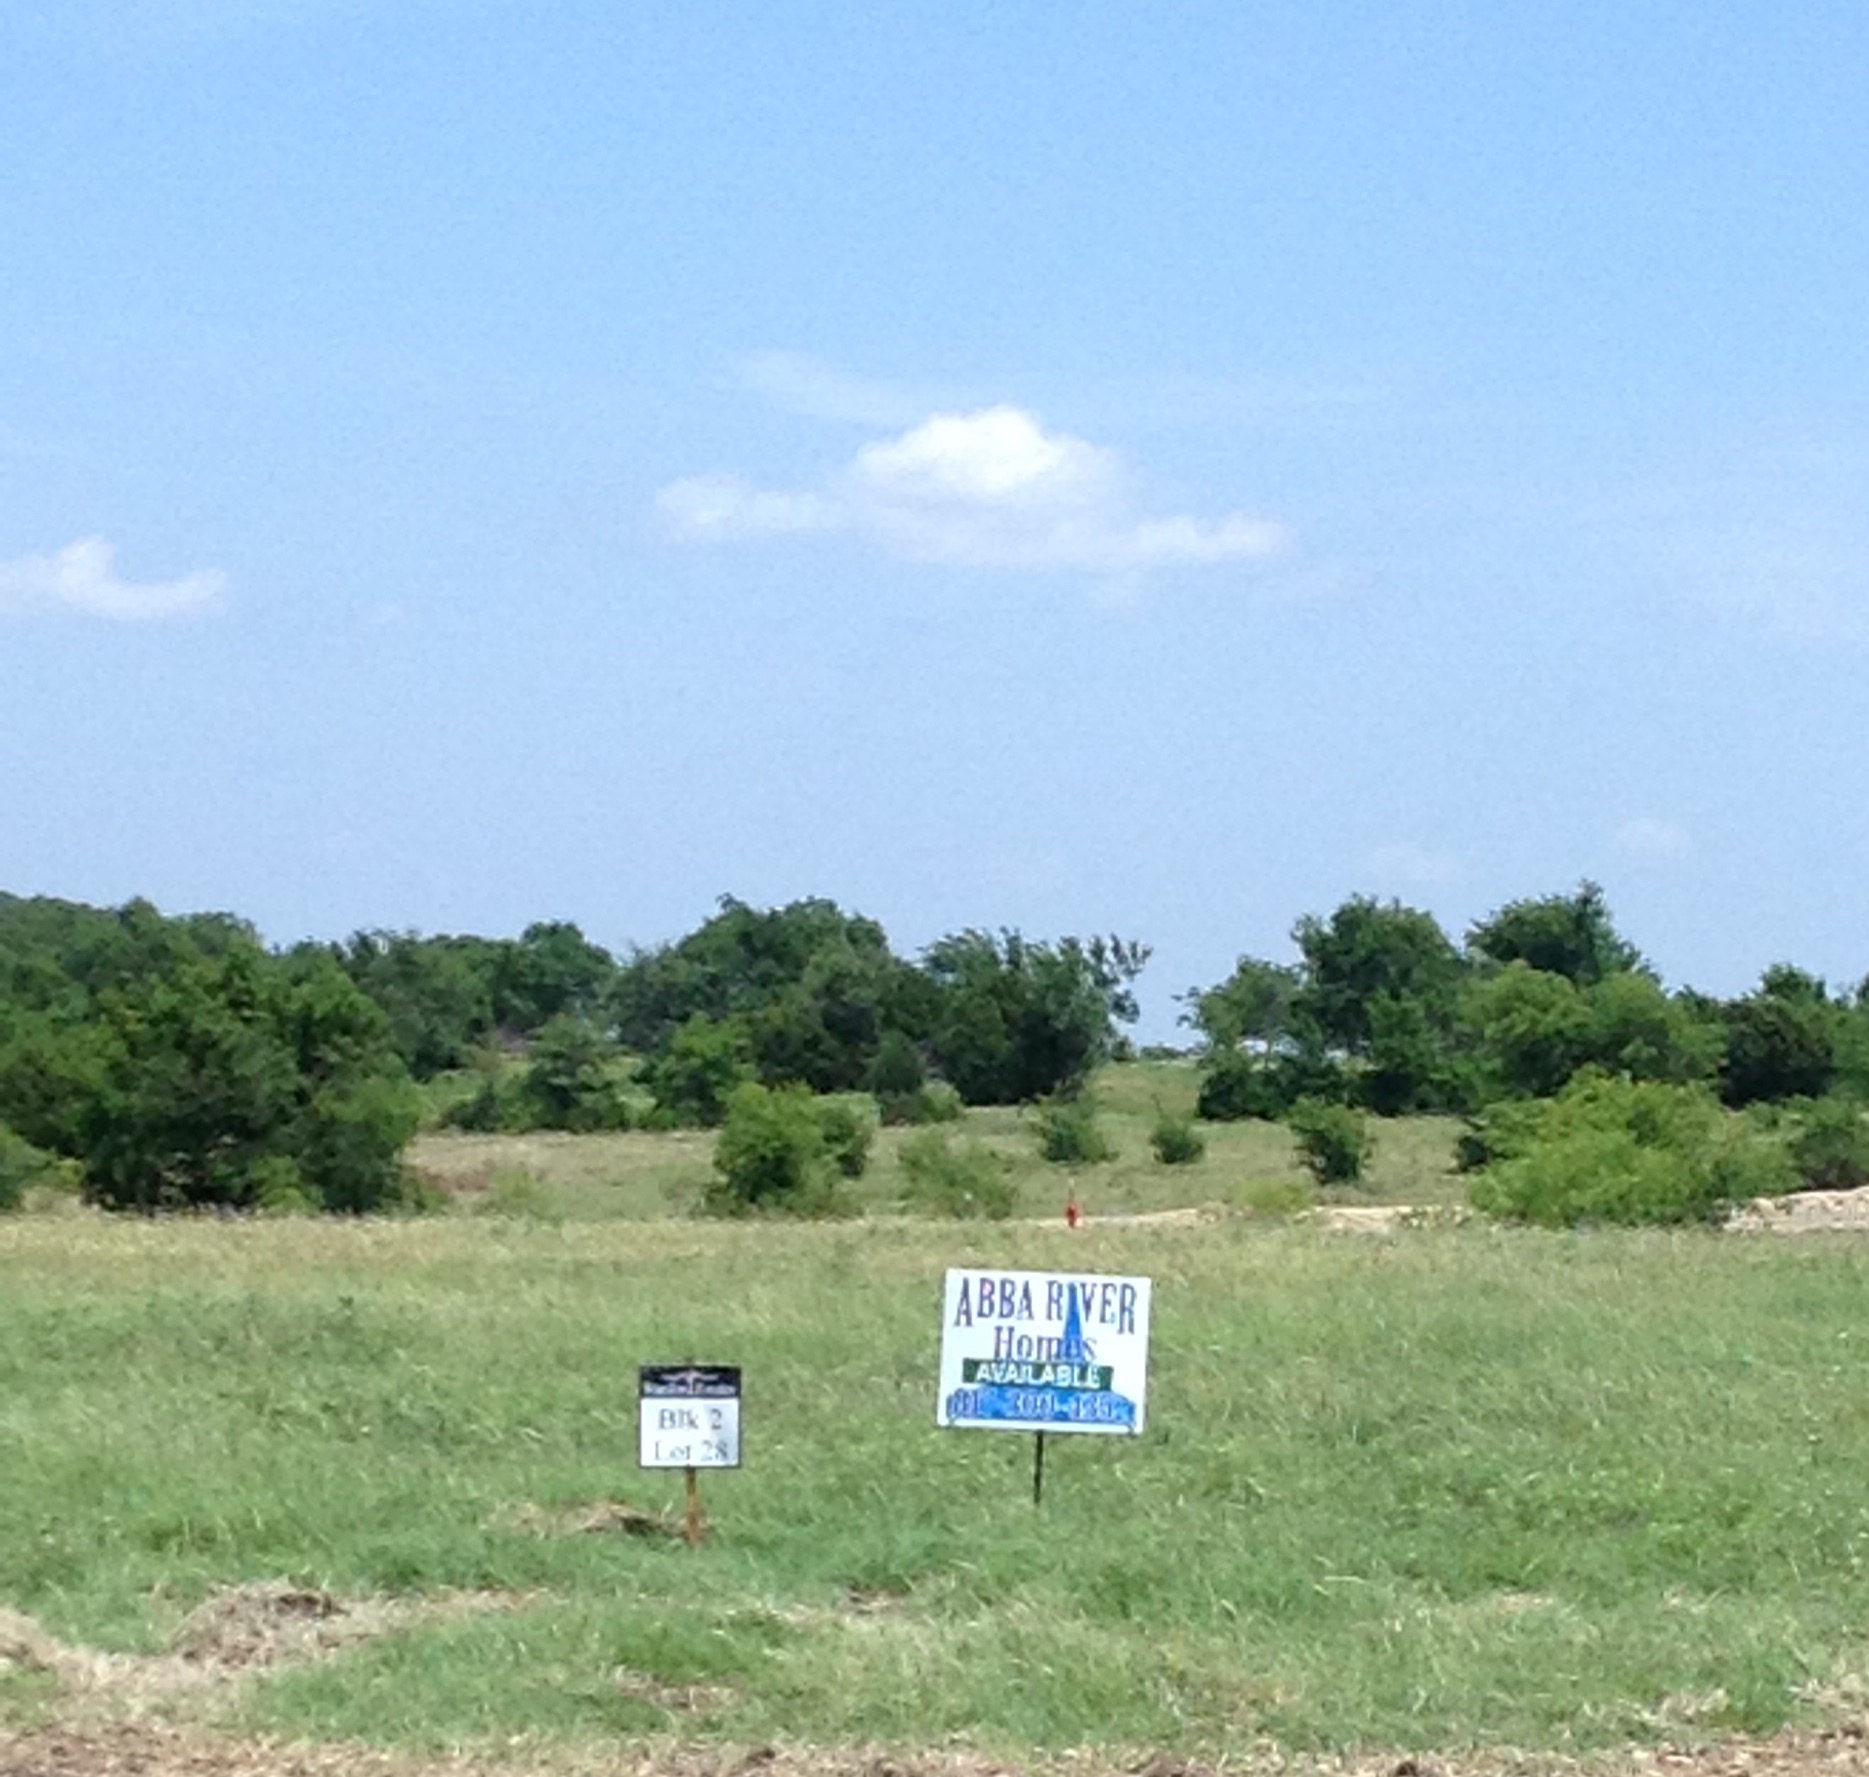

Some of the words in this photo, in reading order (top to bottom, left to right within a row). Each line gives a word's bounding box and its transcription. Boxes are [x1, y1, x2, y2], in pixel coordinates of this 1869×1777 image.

[954, 1277, 1034, 1328] ABBA
[1046, 1280, 1137, 1334] RIVER
[976, 1361, 1101, 1390] AVAILABLE
[659, 1408, 699, 1430] Blk
[711, 1408, 722, 1430] 2
[655, 1440, 690, 1461] Lot
